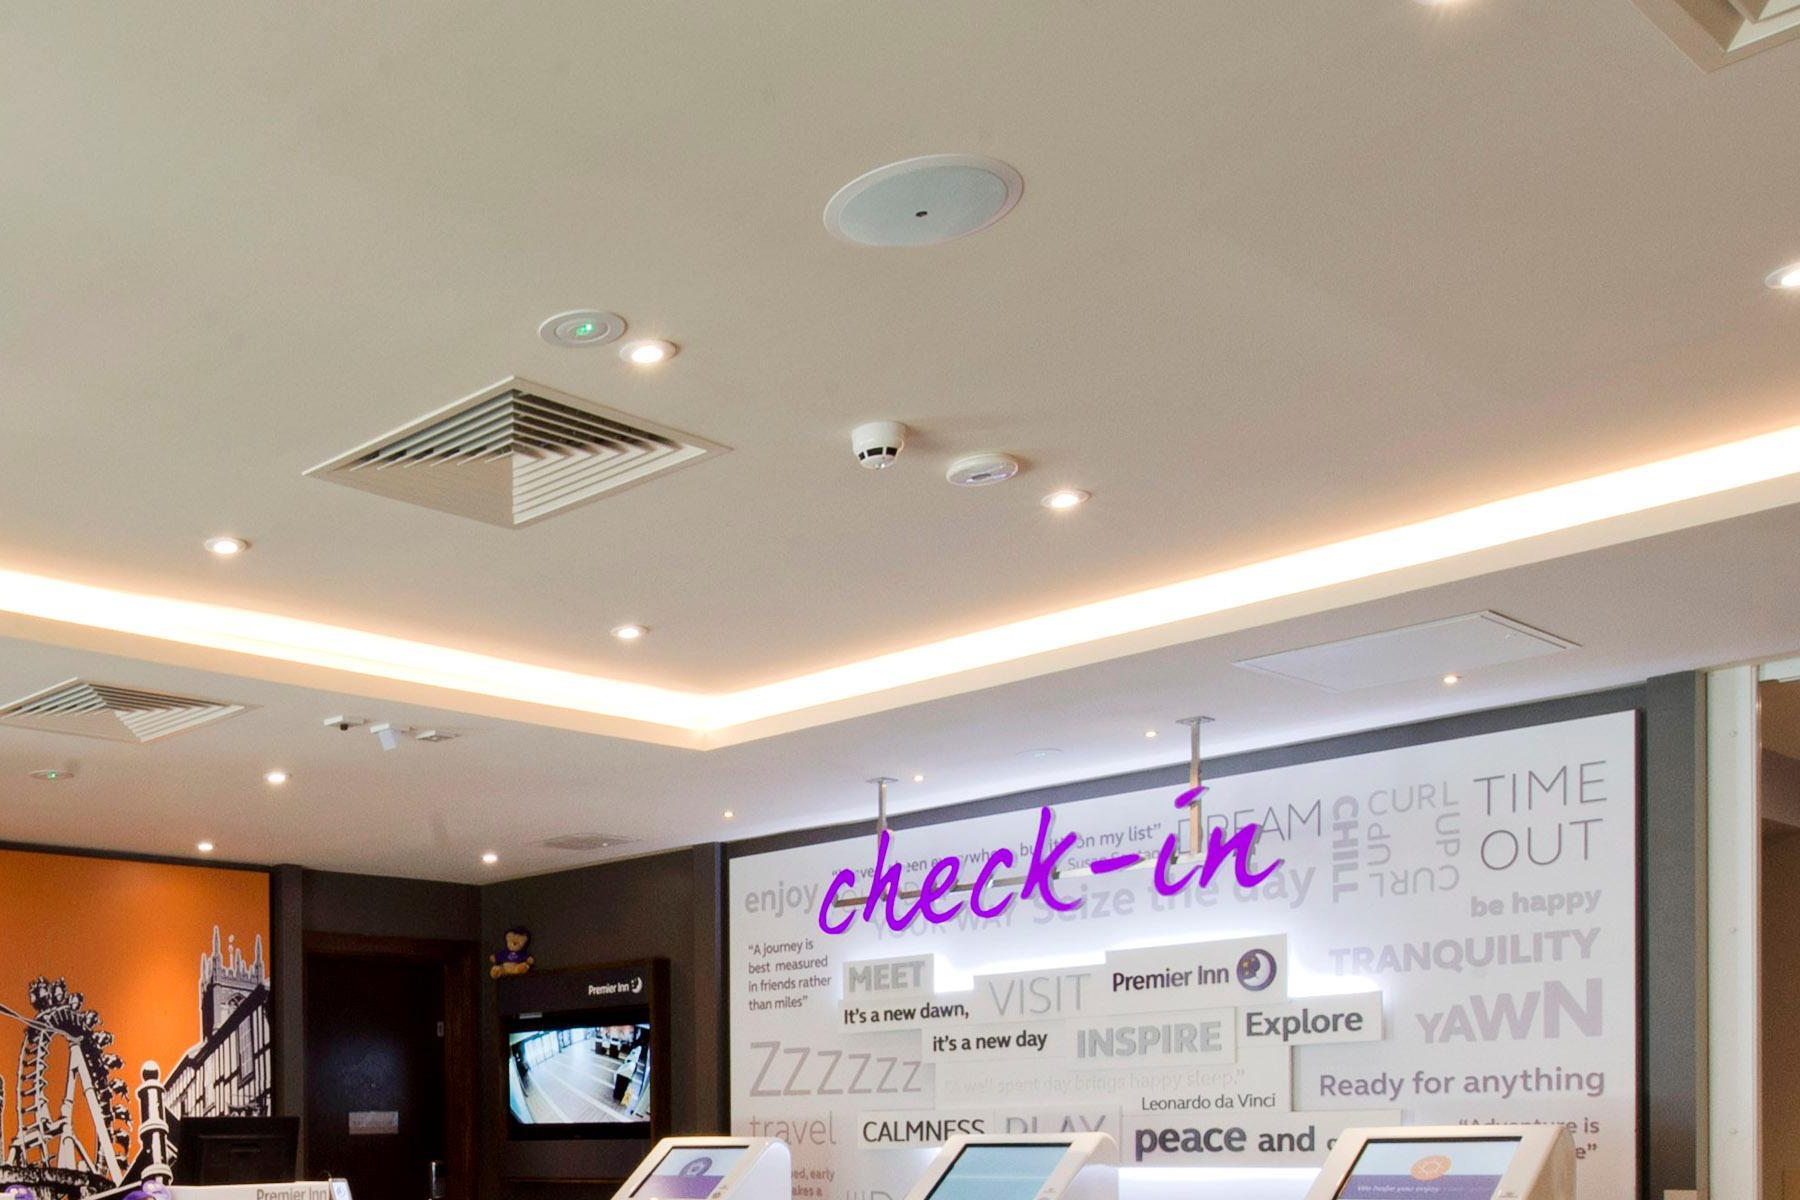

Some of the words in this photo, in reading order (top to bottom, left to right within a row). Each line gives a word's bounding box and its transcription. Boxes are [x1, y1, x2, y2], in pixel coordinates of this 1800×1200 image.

[1368, 781, 1459, 816] CURL
[1473, 760, 1607, 816] TIME
[1099, 832, 1125, 846] my
[1332, 795, 1359, 903] CHILL
[1367, 822, 1392, 866] UP
[1436, 812, 1461, 857] UP
[1480, 818, 1604, 871] OUT
[818, 786, 1285, 936] check-in
[744, 880, 819, 918] enjoy
[1369, 865, 1459, 899] CURL
[1470, 896, 1504, 917] be
[1512, 888, 1602, 920] happy
[748, 963, 771, 975] best
[775, 955, 828, 971] measured
[762, 940, 803, 958] journey
[805, 938, 814, 951] is
[1329, 927, 1601, 977] TRANQUILITY
[588, 983, 617, 996] Premier
[617, 981, 630, 993] Inn
[748, 981, 758, 993] in
[760, 976, 796, 992] friends
[799, 974, 832, 987] rather
[849, 960, 926, 992] MEET
[1112, 967, 1193, 992] Premier
[1197, 964, 1230, 985] Inn
[748, 998, 773, 1011] than
[774, 995, 808, 1010] miles”
[988, 972, 1093, 1016] VISIT
[1415, 977, 1604, 1044] YAWN
[844, 1007, 867, 1025] It’s
[870, 1012, 880, 1023] a
[884, 1006, 916, 1022] new
[920, 1002, 970, 1020] dawn,
[1246, 1008, 1364, 1042] Explore
[933, 1035, 957, 1052] it’s
[961, 1039, 971, 1051] a
[975, 1035, 1012, 1050] new
[1015, 1029, 1048, 1052] day
[1077, 1020, 1222, 1059] INSPIRE
[1074, 1073, 1125, 1096] brings
[1129, 1070, 1182, 1095] happy
[1319, 1072, 1404, 1100] Ready
[1412, 1069, 1455, 1095] for
[1463, 1066, 1606, 1098] anything
[1141, 1094, 1211, 1111] Leonardo
[1214, 1093, 1234, 1109] da
[1237, 1092, 1276, 1108] Vinci
[750, 1111, 837, 1146] travel
[1584, 1117, 1600, 1134] is
[1134, 1126, 1247, 1162] peace
[1257, 1125, 1316, 1153] and
[810, 1168, 836, 1182] early
[816, 1187, 823, 1197] a
